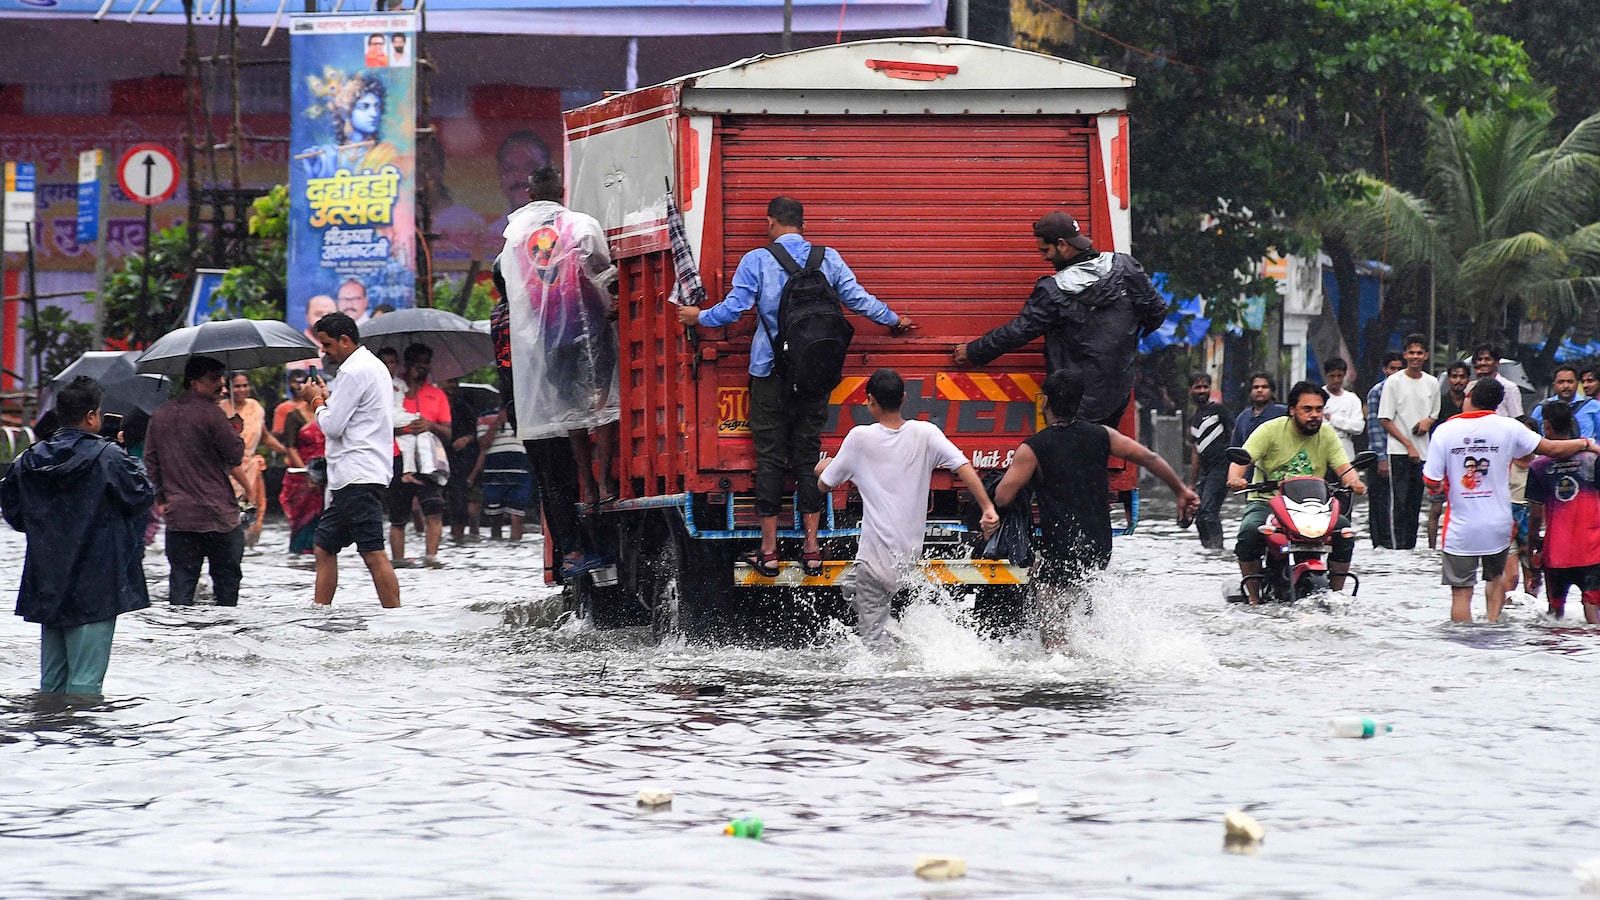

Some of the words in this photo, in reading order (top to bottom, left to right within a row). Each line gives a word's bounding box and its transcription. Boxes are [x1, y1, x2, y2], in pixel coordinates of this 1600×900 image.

[306, 166, 399, 201] दहीहंडी
[309, 198, 393, 227] उत्सव
[973, 450, 1001, 468] Wait
